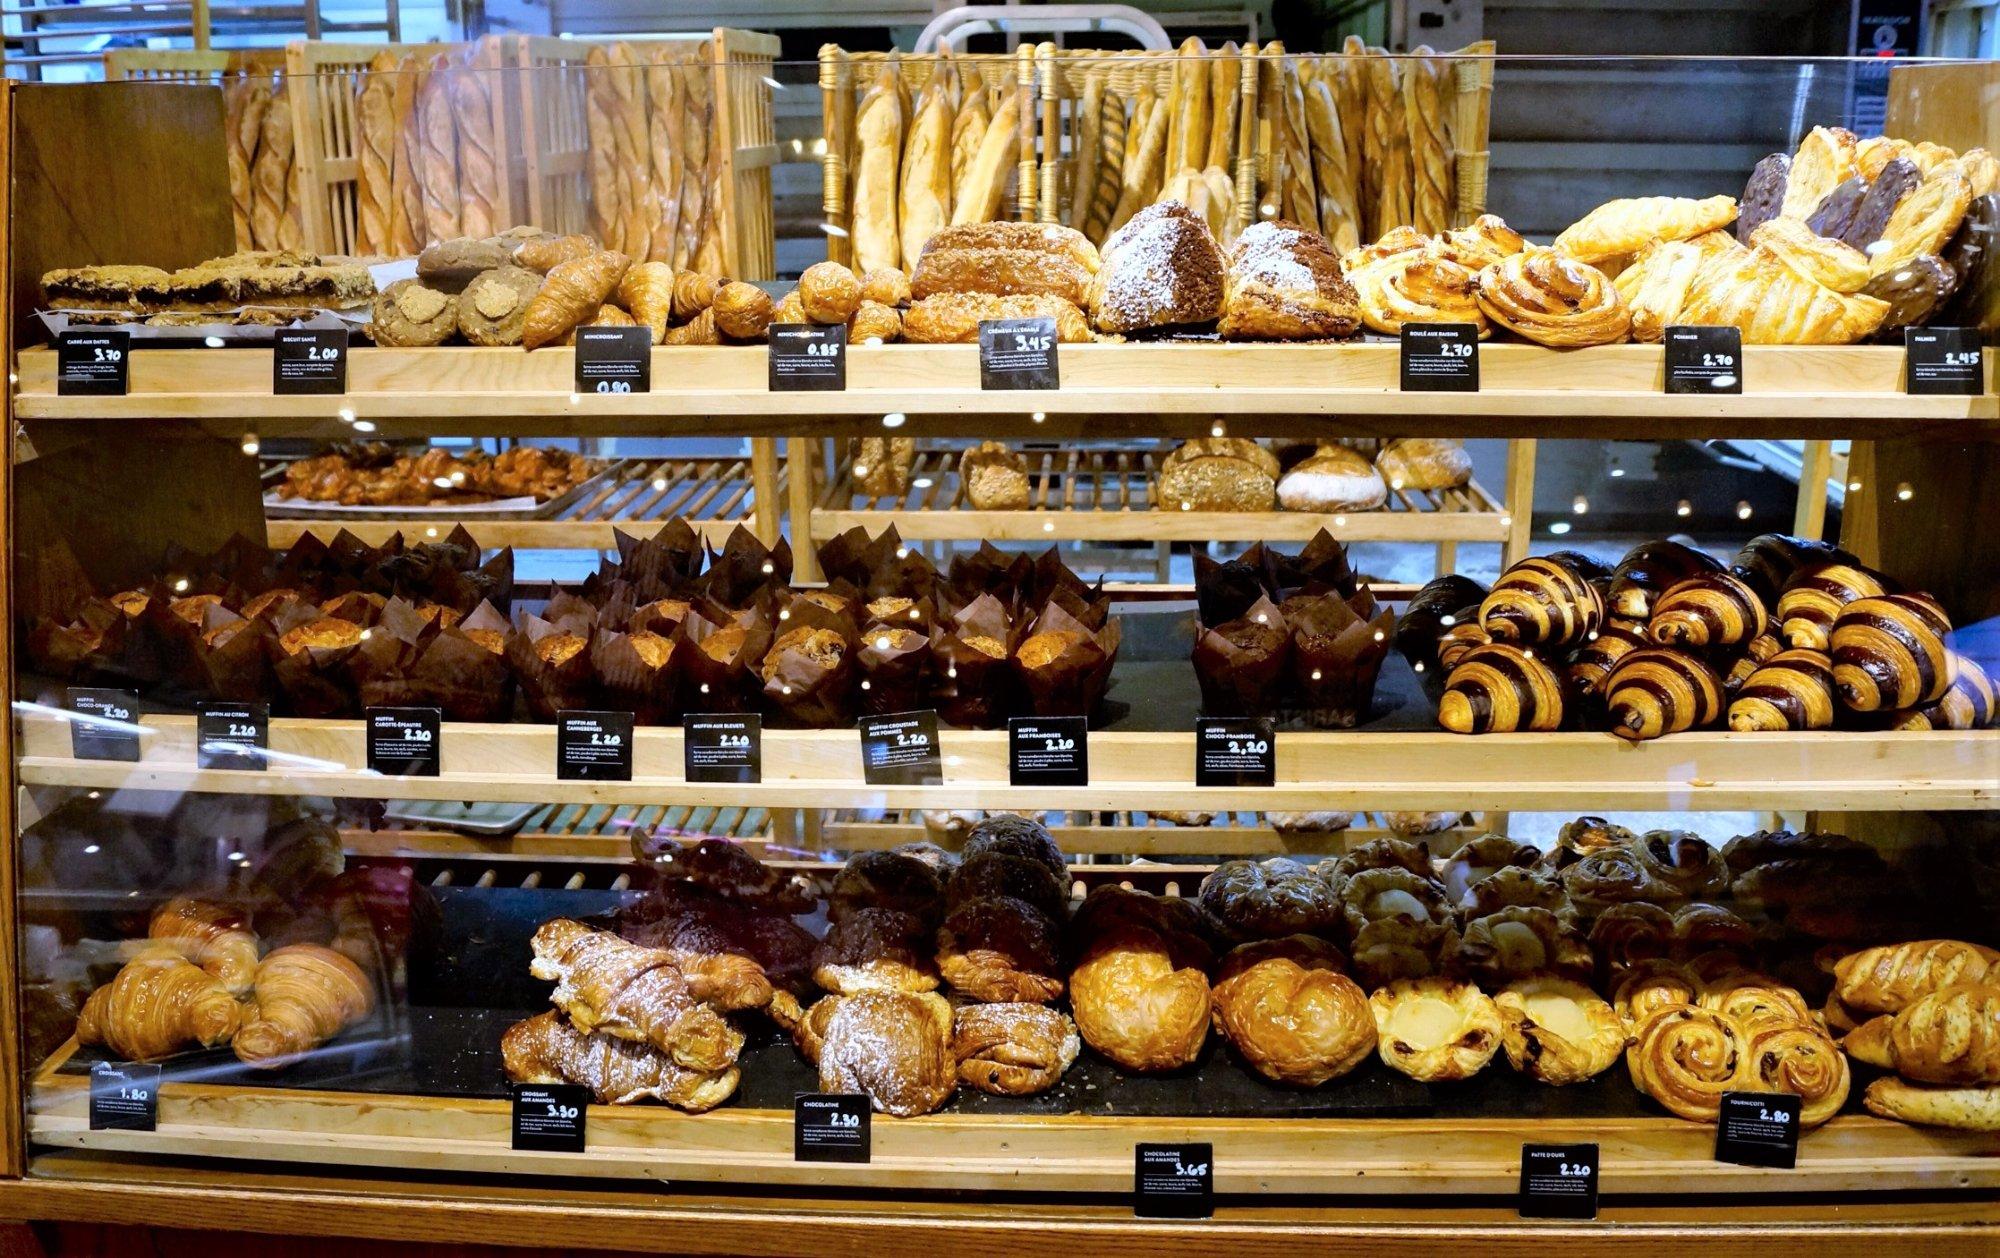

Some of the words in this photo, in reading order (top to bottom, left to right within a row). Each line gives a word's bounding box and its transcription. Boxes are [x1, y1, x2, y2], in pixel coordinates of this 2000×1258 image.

[808, 343, 839, 356] 0.85
[1016, 335, 1052, 351] 3.45
[309, 346, 338, 360] 2.00
[1703, 353, 1733, 366] 2.70
[1946, 352, 1980, 365] 2.45
[104, 707, 129, 719] 2.20
[230, 724, 256, 736] 2.20
[404, 728, 431, 741] 2.20
[591, 733, 621, 745] 2.20
[720, 734, 749, 747] 2.20
[897, 733, 928, 746] 2.20
[1046, 738, 1074, 751] 2.20
[120, 1088, 147, 1100] 1.80
[547, 1104, 578, 1118] 3.30
[1760, 1108, 1790, 1123] 2.80
[831, 1112, 859, 1127] 2.30
[1175, 1162, 1207, 1176] 3.65
[1560, 1163, 1590, 1176] 2.20
